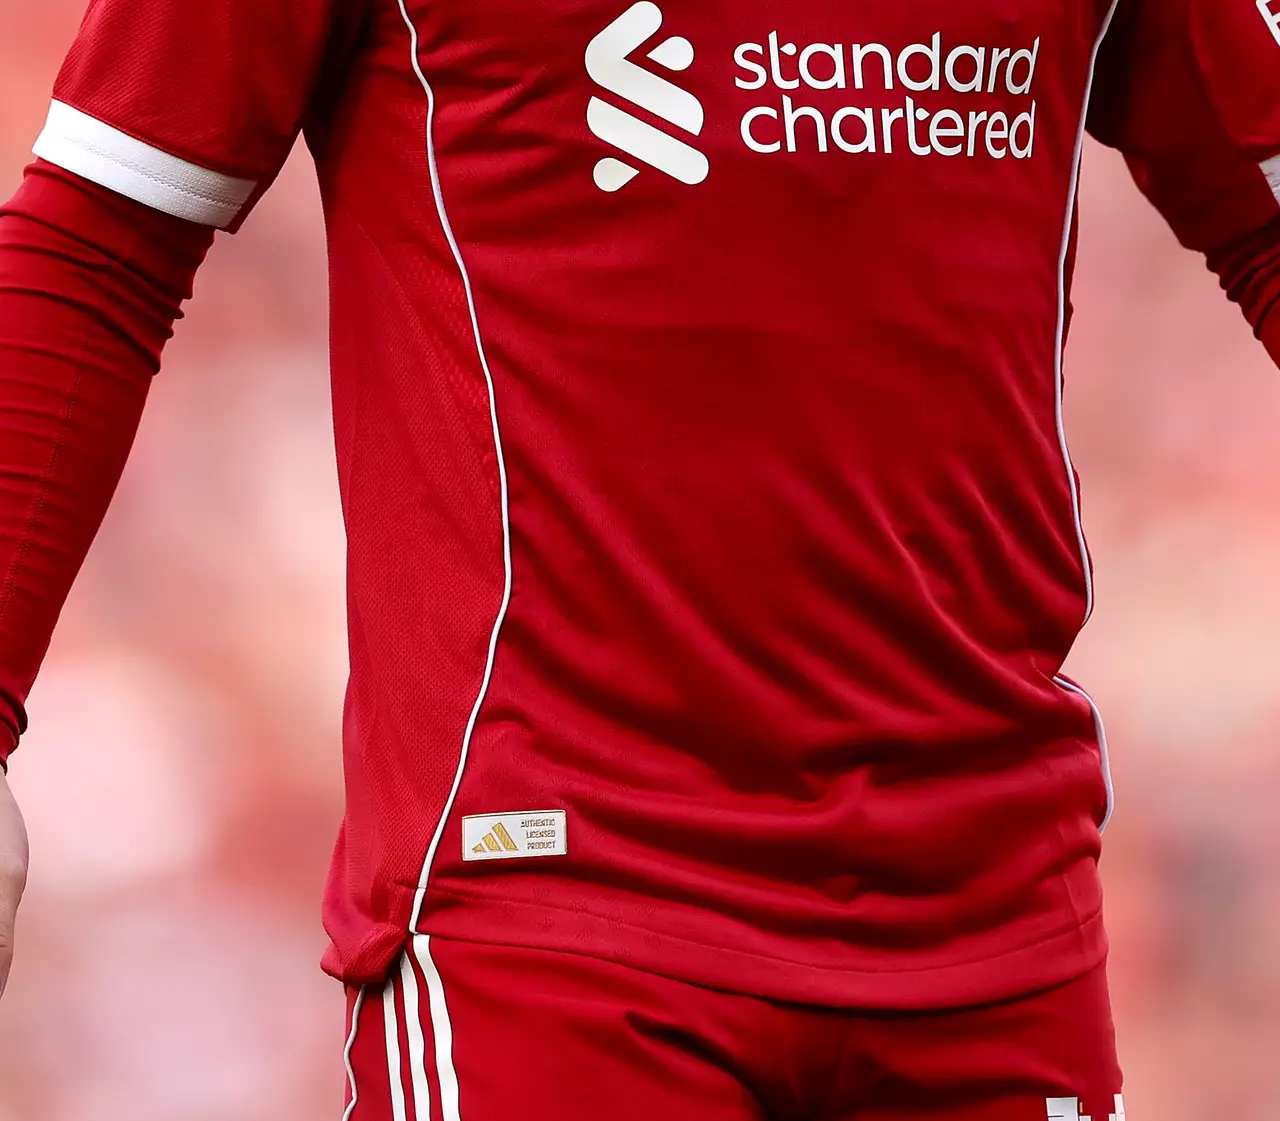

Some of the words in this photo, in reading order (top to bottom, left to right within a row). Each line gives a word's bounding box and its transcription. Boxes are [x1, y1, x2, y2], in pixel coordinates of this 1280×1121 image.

[733, 30, 1040, 95] standard
[740, 94, 1037, 160] chartered
[527, 840, 556, 850] PRODUCT
